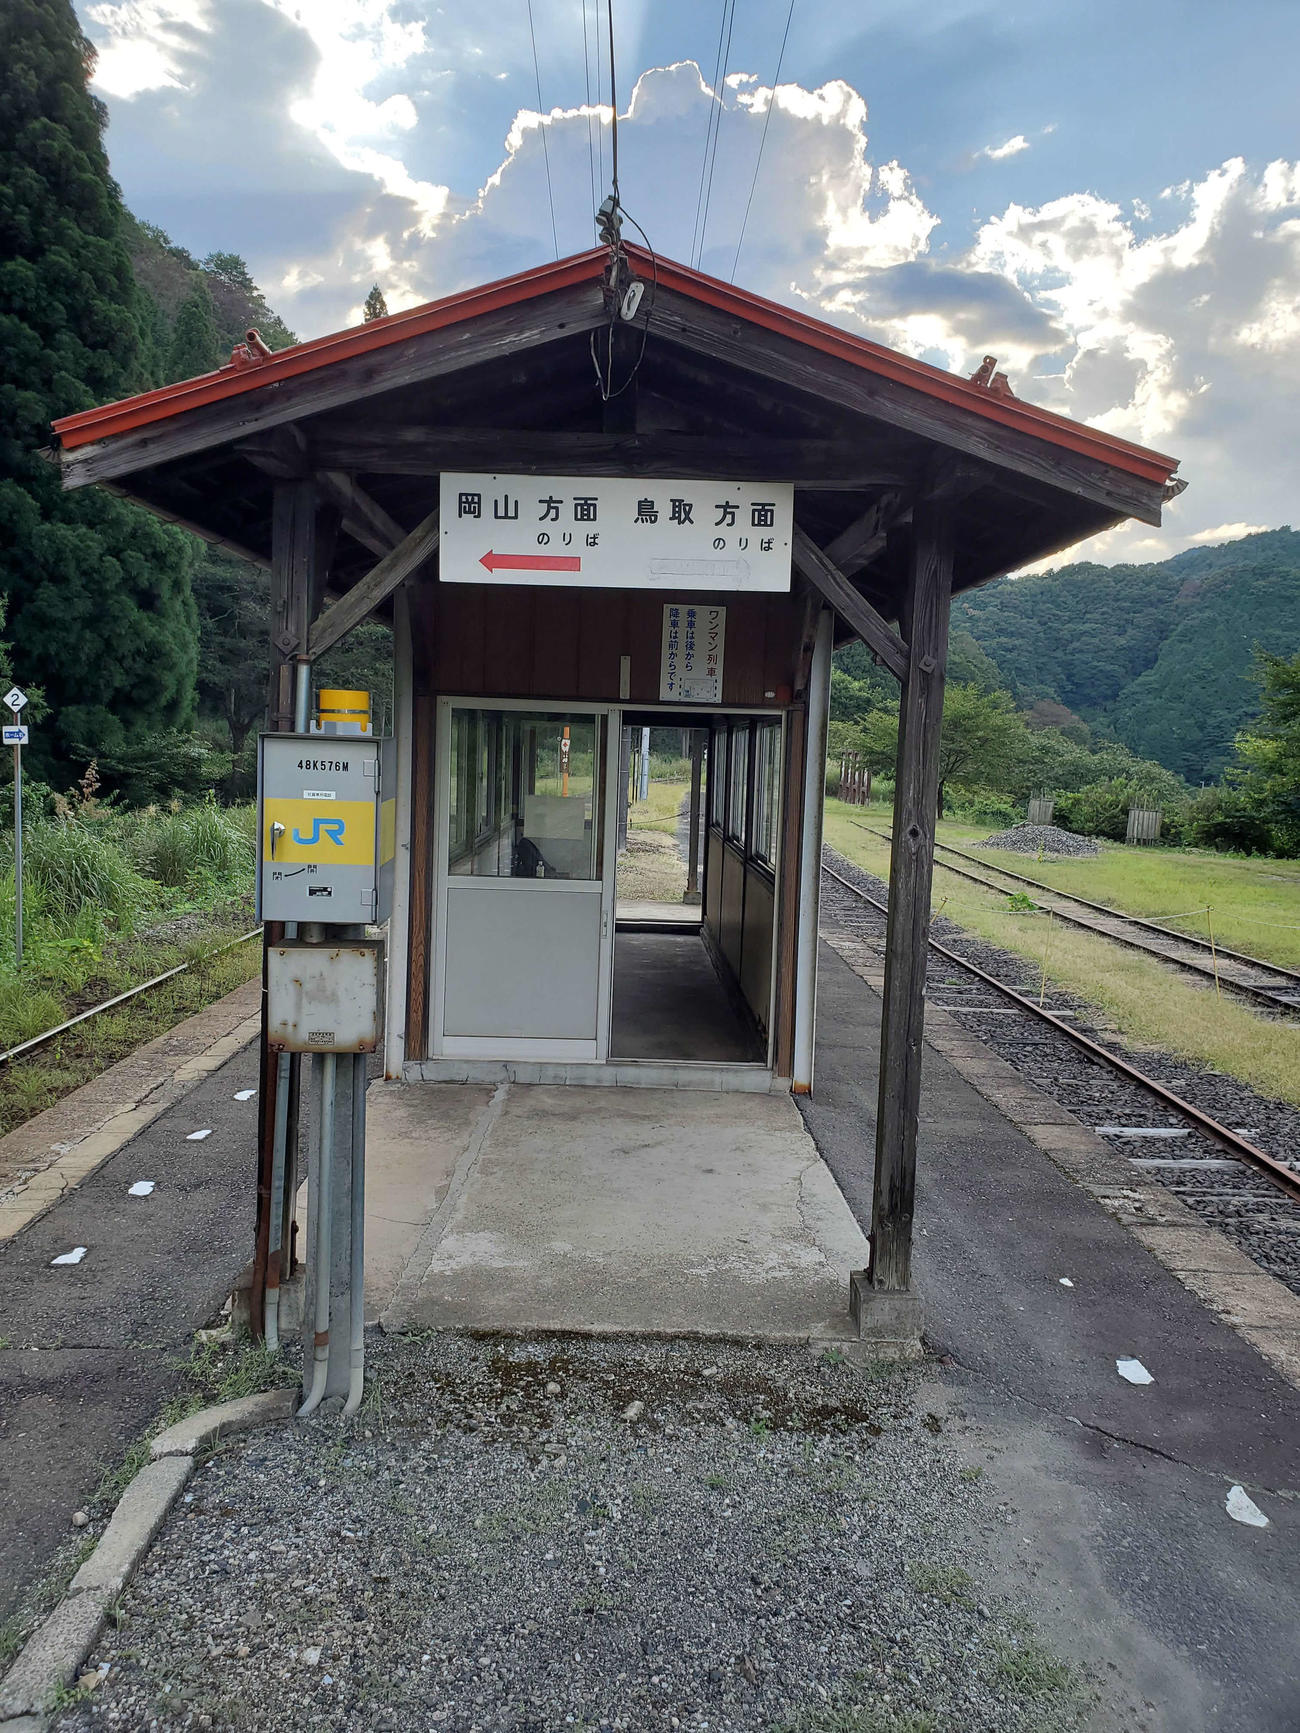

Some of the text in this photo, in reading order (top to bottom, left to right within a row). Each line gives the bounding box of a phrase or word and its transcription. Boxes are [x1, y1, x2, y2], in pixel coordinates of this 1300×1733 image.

[458, 492, 598, 522] 岡山方面
[634, 497, 776, 528] 鳥取方面
[537, 531, 600, 547] のりば
[713, 536, 774, 552] のりば
[666, 607, 679, 692] 降車は前からです
[684, 608, 697, 672] 乗車は後から
[705, 610, 719, 678] ワンマン列車
[11, 693, 20, 706] 2
[297, 759, 349, 773] 48K576M
[293, 817, 345, 846] JR
